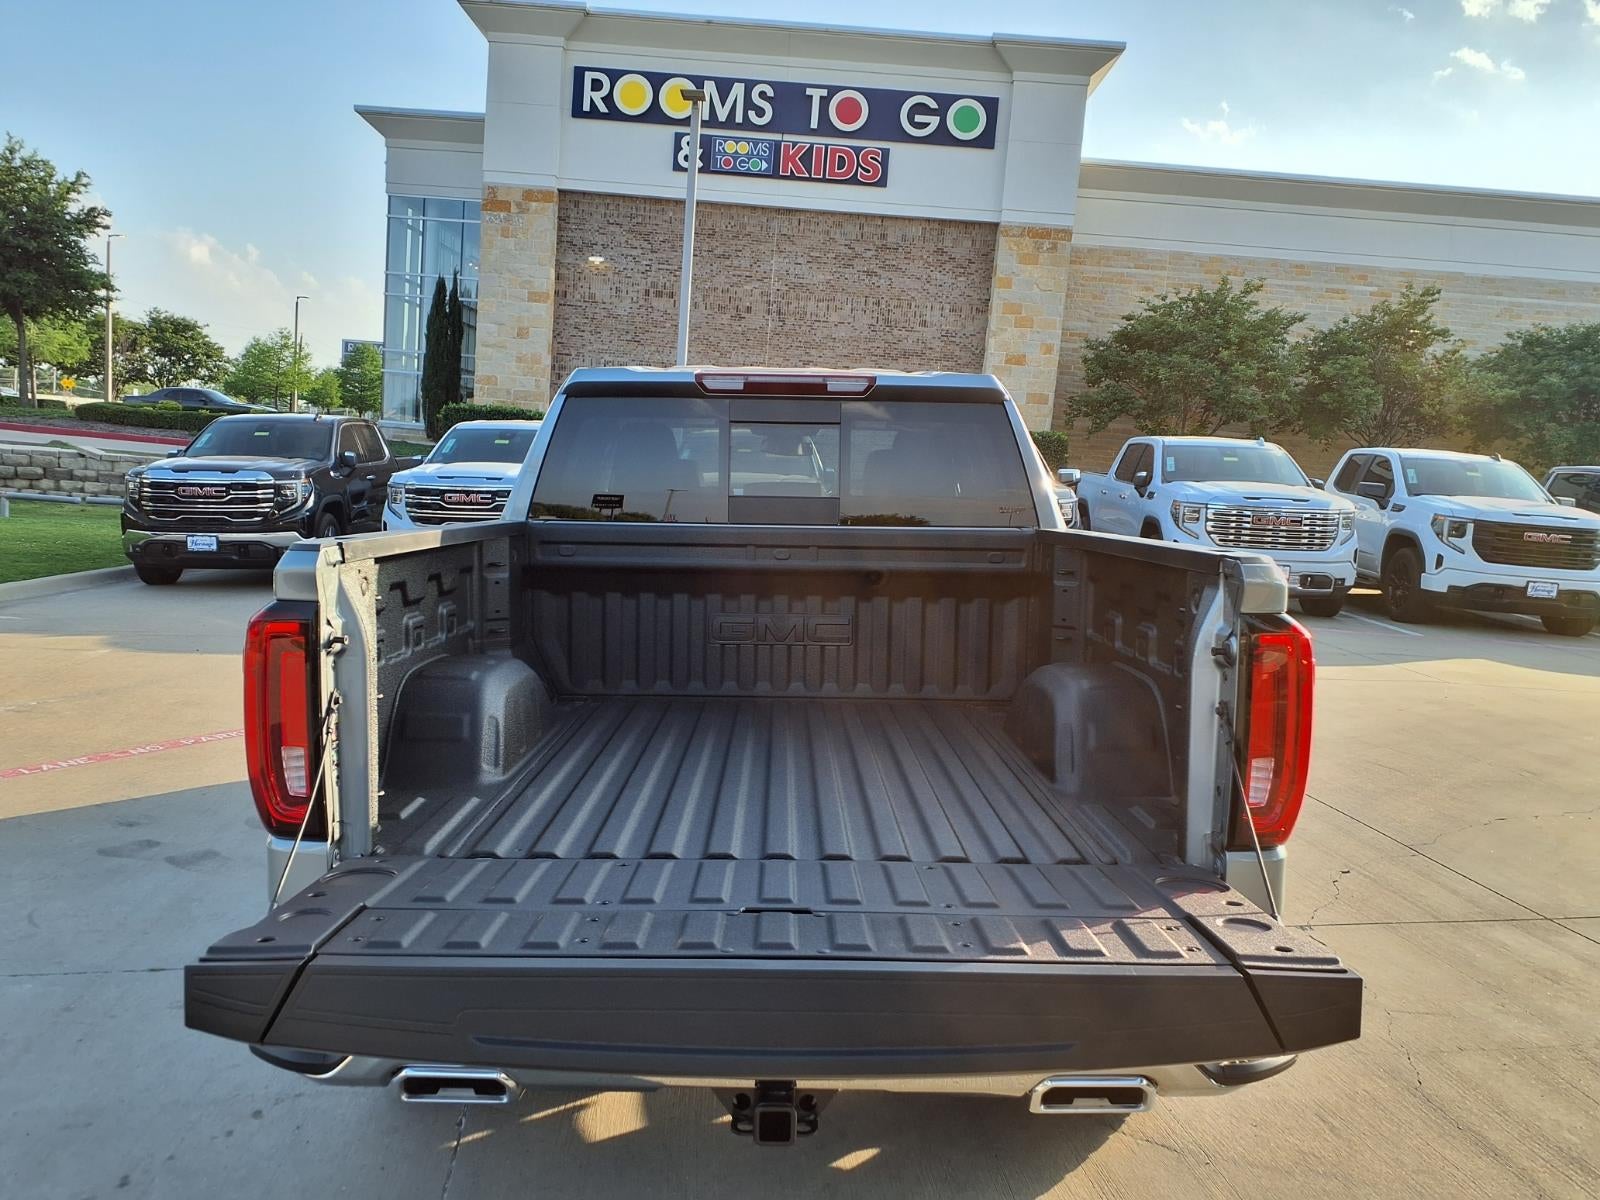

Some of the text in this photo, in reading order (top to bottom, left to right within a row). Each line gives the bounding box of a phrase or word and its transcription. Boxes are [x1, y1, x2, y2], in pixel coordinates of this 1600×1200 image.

[582, 71, 987, 140] ROOMS TO GO
[715, 140, 769, 156] ROOMS
[715, 155, 762, 171] TO GO
[779, 141, 882, 183] KIDS
[178, 486, 226, 496] GMC
[444, 493, 492, 503] GMC
[1253, 516, 1301, 527] GMC
[1524, 532, 1572, 544] GMC
[711, 615, 850, 642] GMC
[18, 757, 95, 773] LANE
